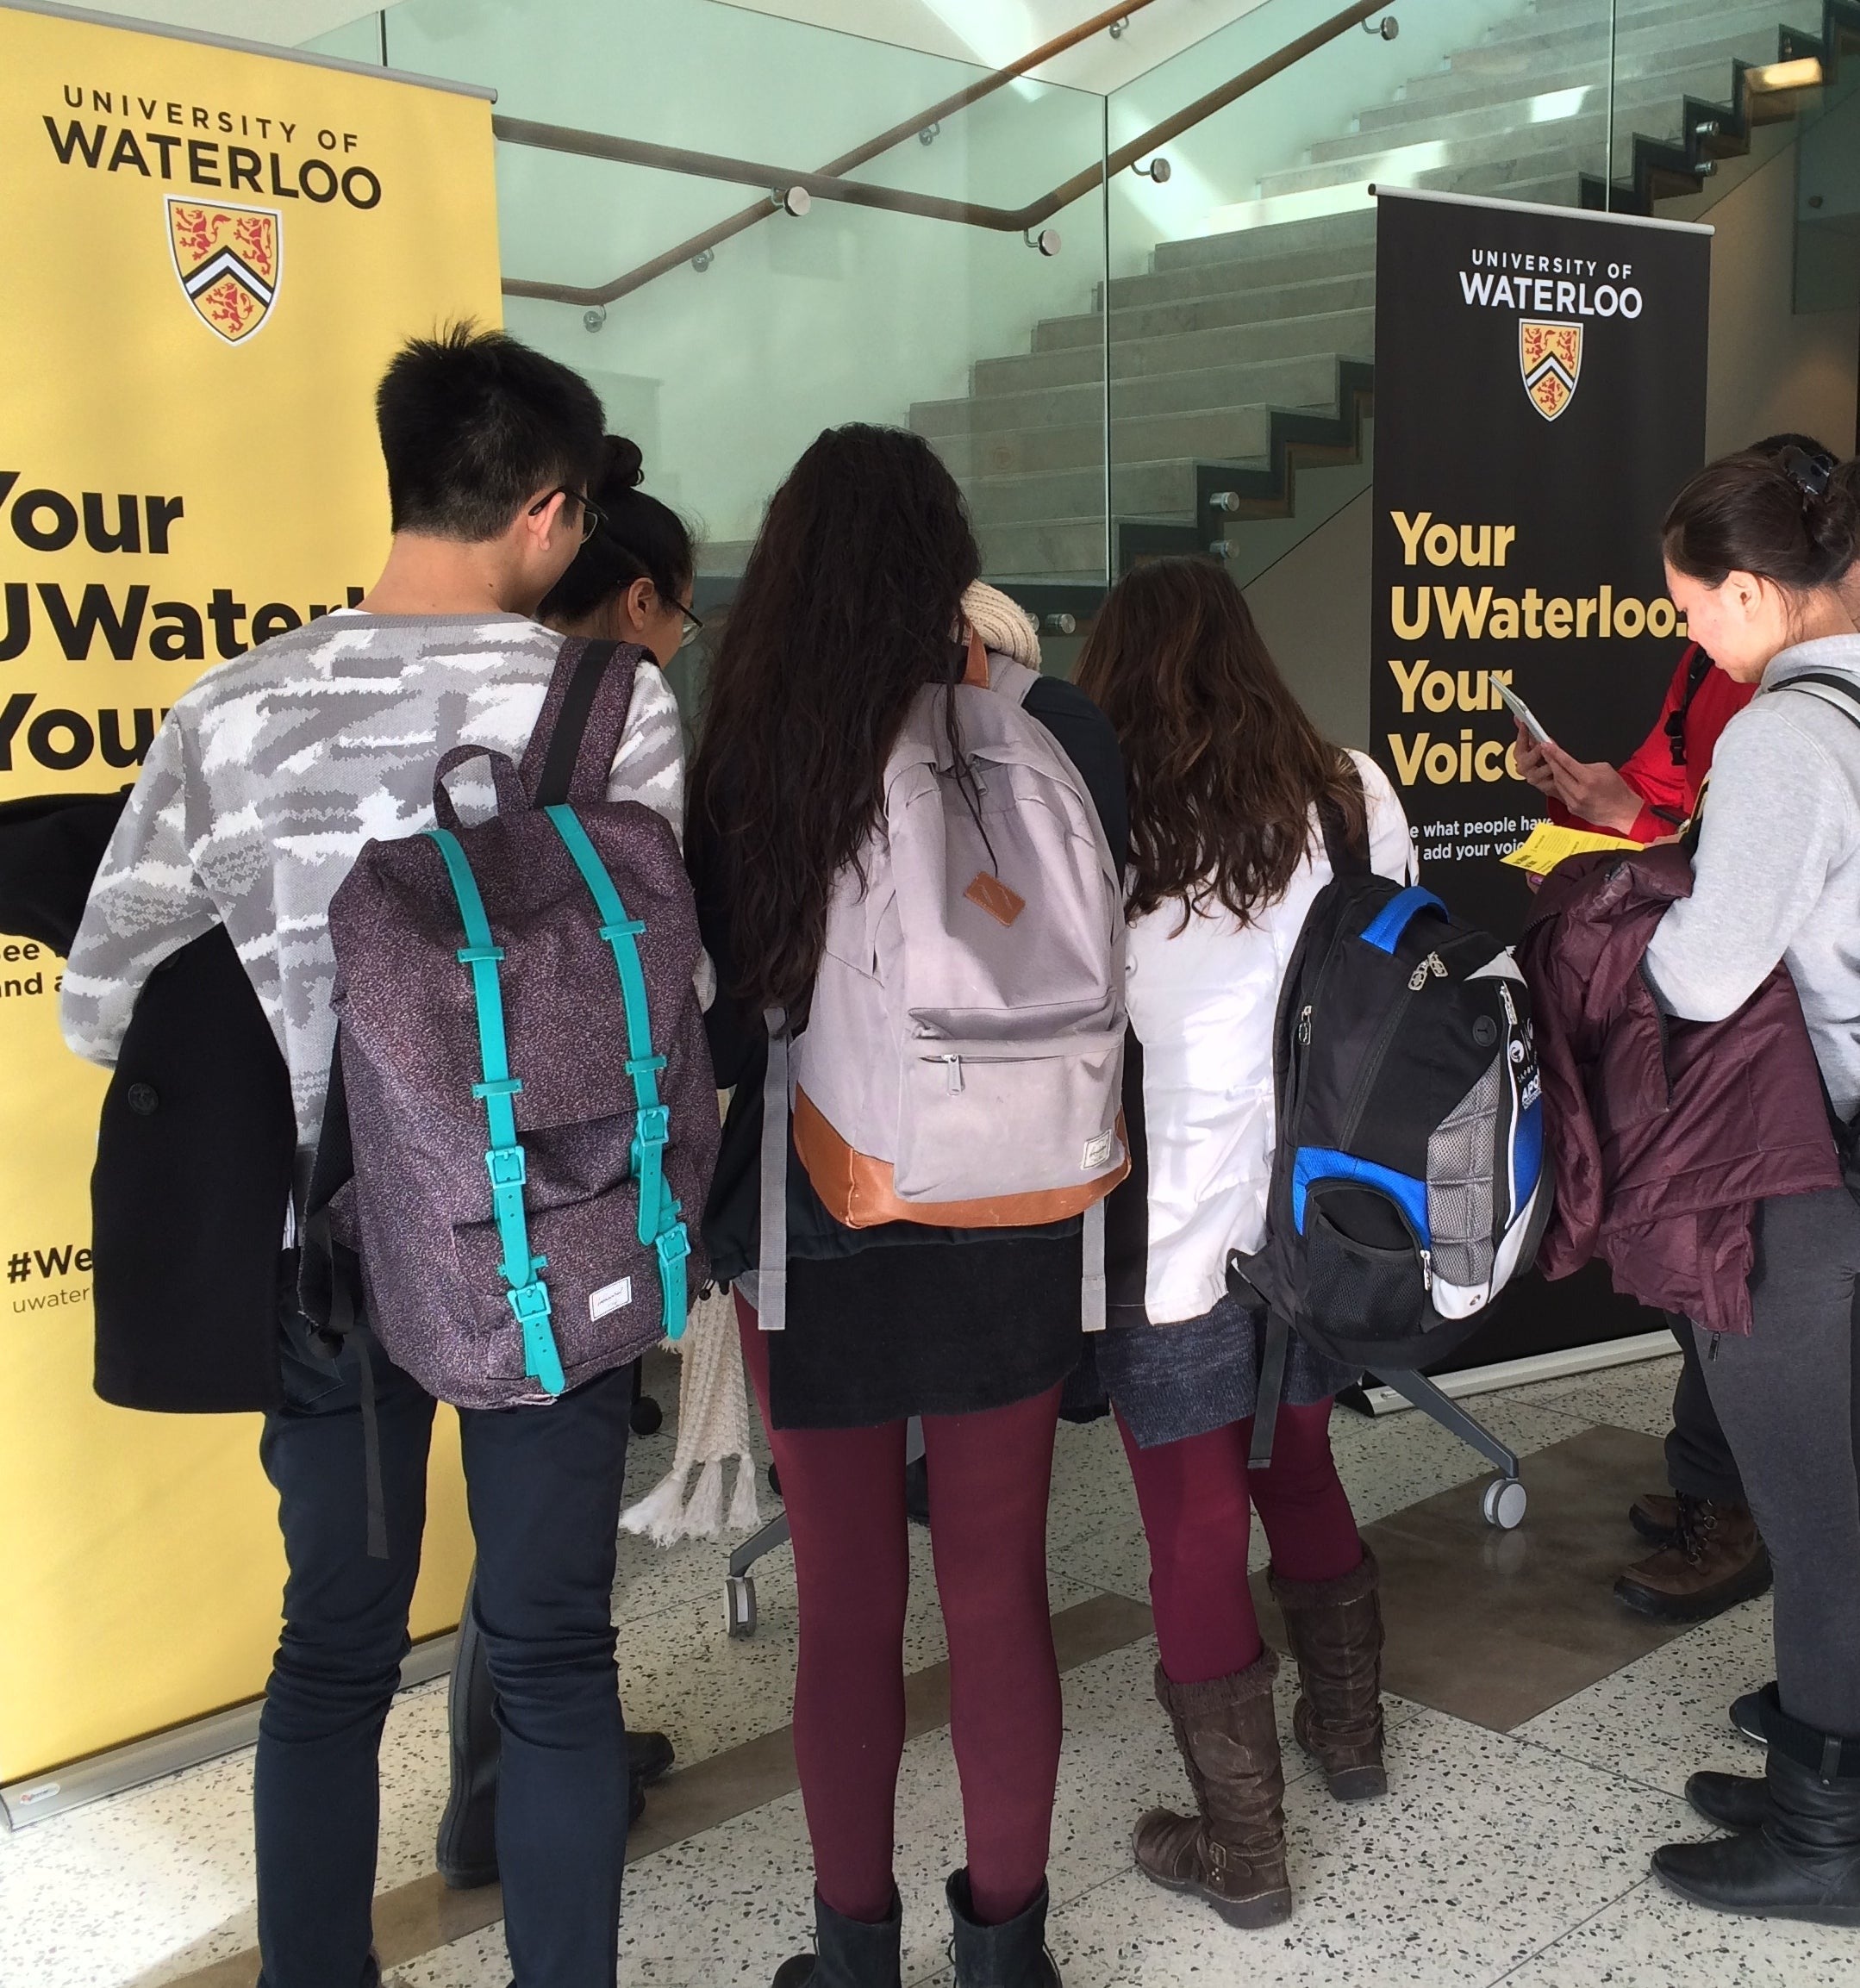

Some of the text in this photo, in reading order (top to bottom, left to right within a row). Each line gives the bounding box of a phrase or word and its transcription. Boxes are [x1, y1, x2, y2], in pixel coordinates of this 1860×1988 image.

[64, 84, 359, 153] UNIVERSITY OF
[42, 115, 382, 210] WATERLOO
[1472, 248, 1632, 280] UNIVERSITY OF
[1458, 271, 1643, 319] WATERLOO
[0, 471, 184, 554] our
[1389, 511, 1515, 567] Your
[0, 583, 365, 662] Wate
[1390, 585, 1688, 640] UWaterloo.
[1388, 659, 1513, 713] Your
[1423, 820, 1460, 838] what
[1464, 816, 1517, 837] people
[1423, 843, 1452, 860] add
[1456, 844, 1492, 860] your
[0, 943, 41, 963] ee
[0, 972, 43, 998] nd
[7, 1244, 93, 1284] #We
[13, 1287, 91, 1313] uwater
